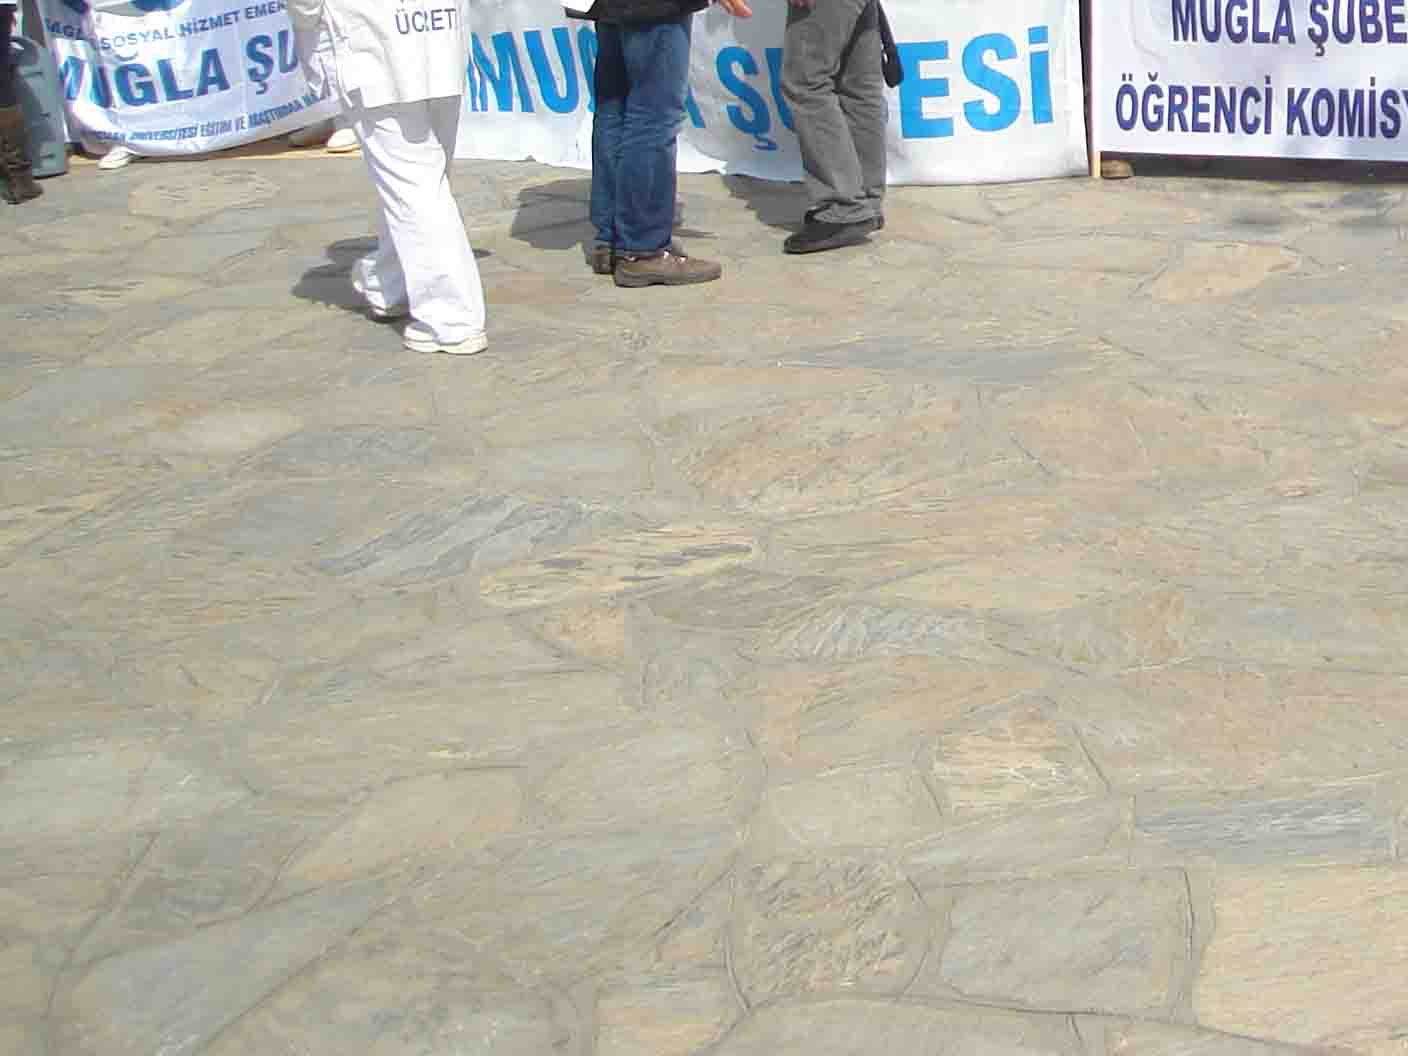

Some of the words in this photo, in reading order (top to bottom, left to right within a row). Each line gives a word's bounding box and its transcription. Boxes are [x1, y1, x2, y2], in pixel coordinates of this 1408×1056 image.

[180, 11, 240, 37] HİZMET
[1115, 72, 1272, 135] ÖĞRENCİ
[235, 113, 246, 130] VE
